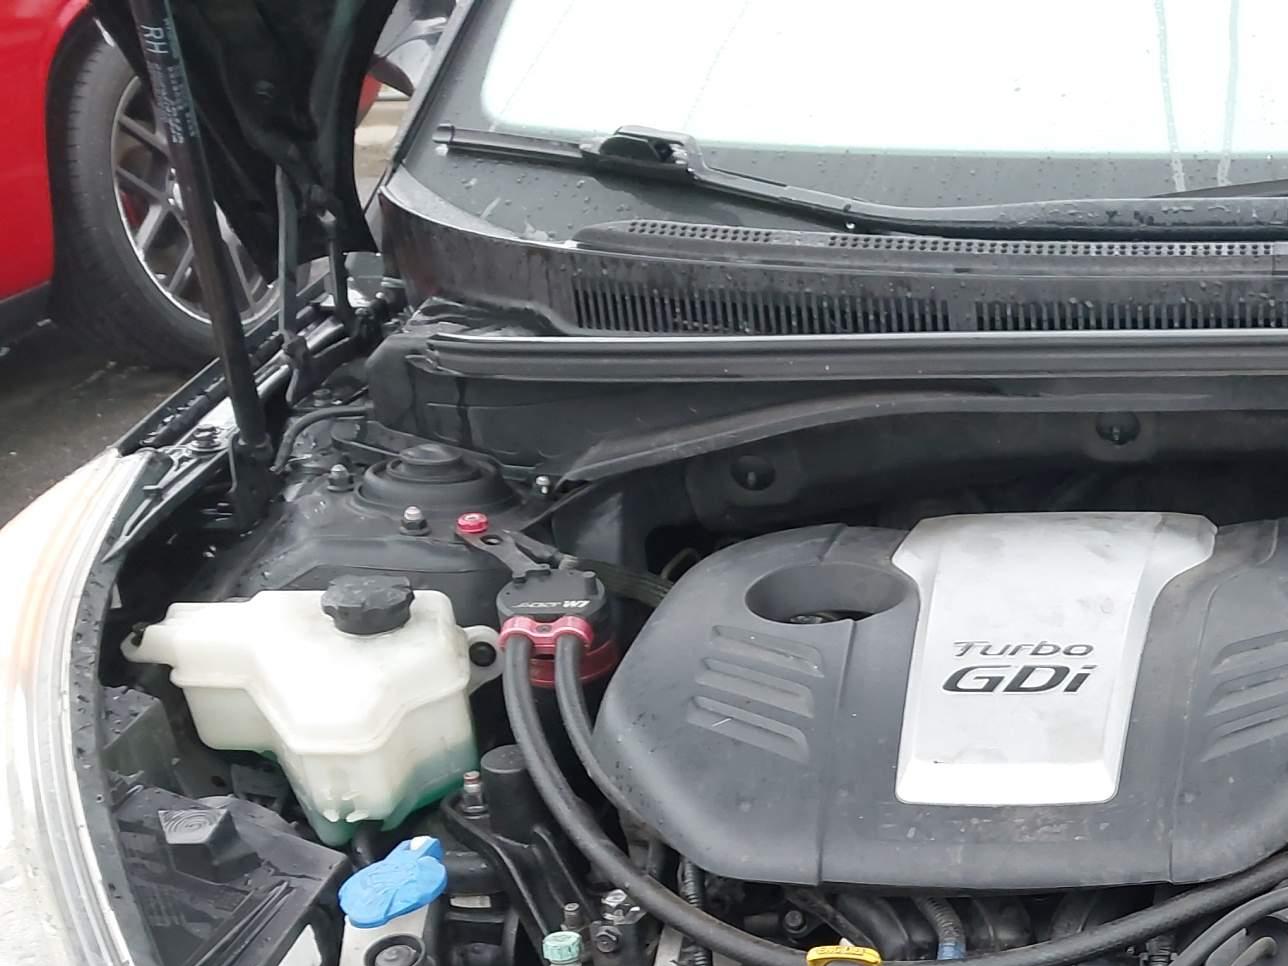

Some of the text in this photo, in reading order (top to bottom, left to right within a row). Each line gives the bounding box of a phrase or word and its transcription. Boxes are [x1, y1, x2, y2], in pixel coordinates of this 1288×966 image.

[140, 24, 169, 54] RH
[953, 640, 1095, 657] Turbo
[942, 664, 1098, 693] GDi
